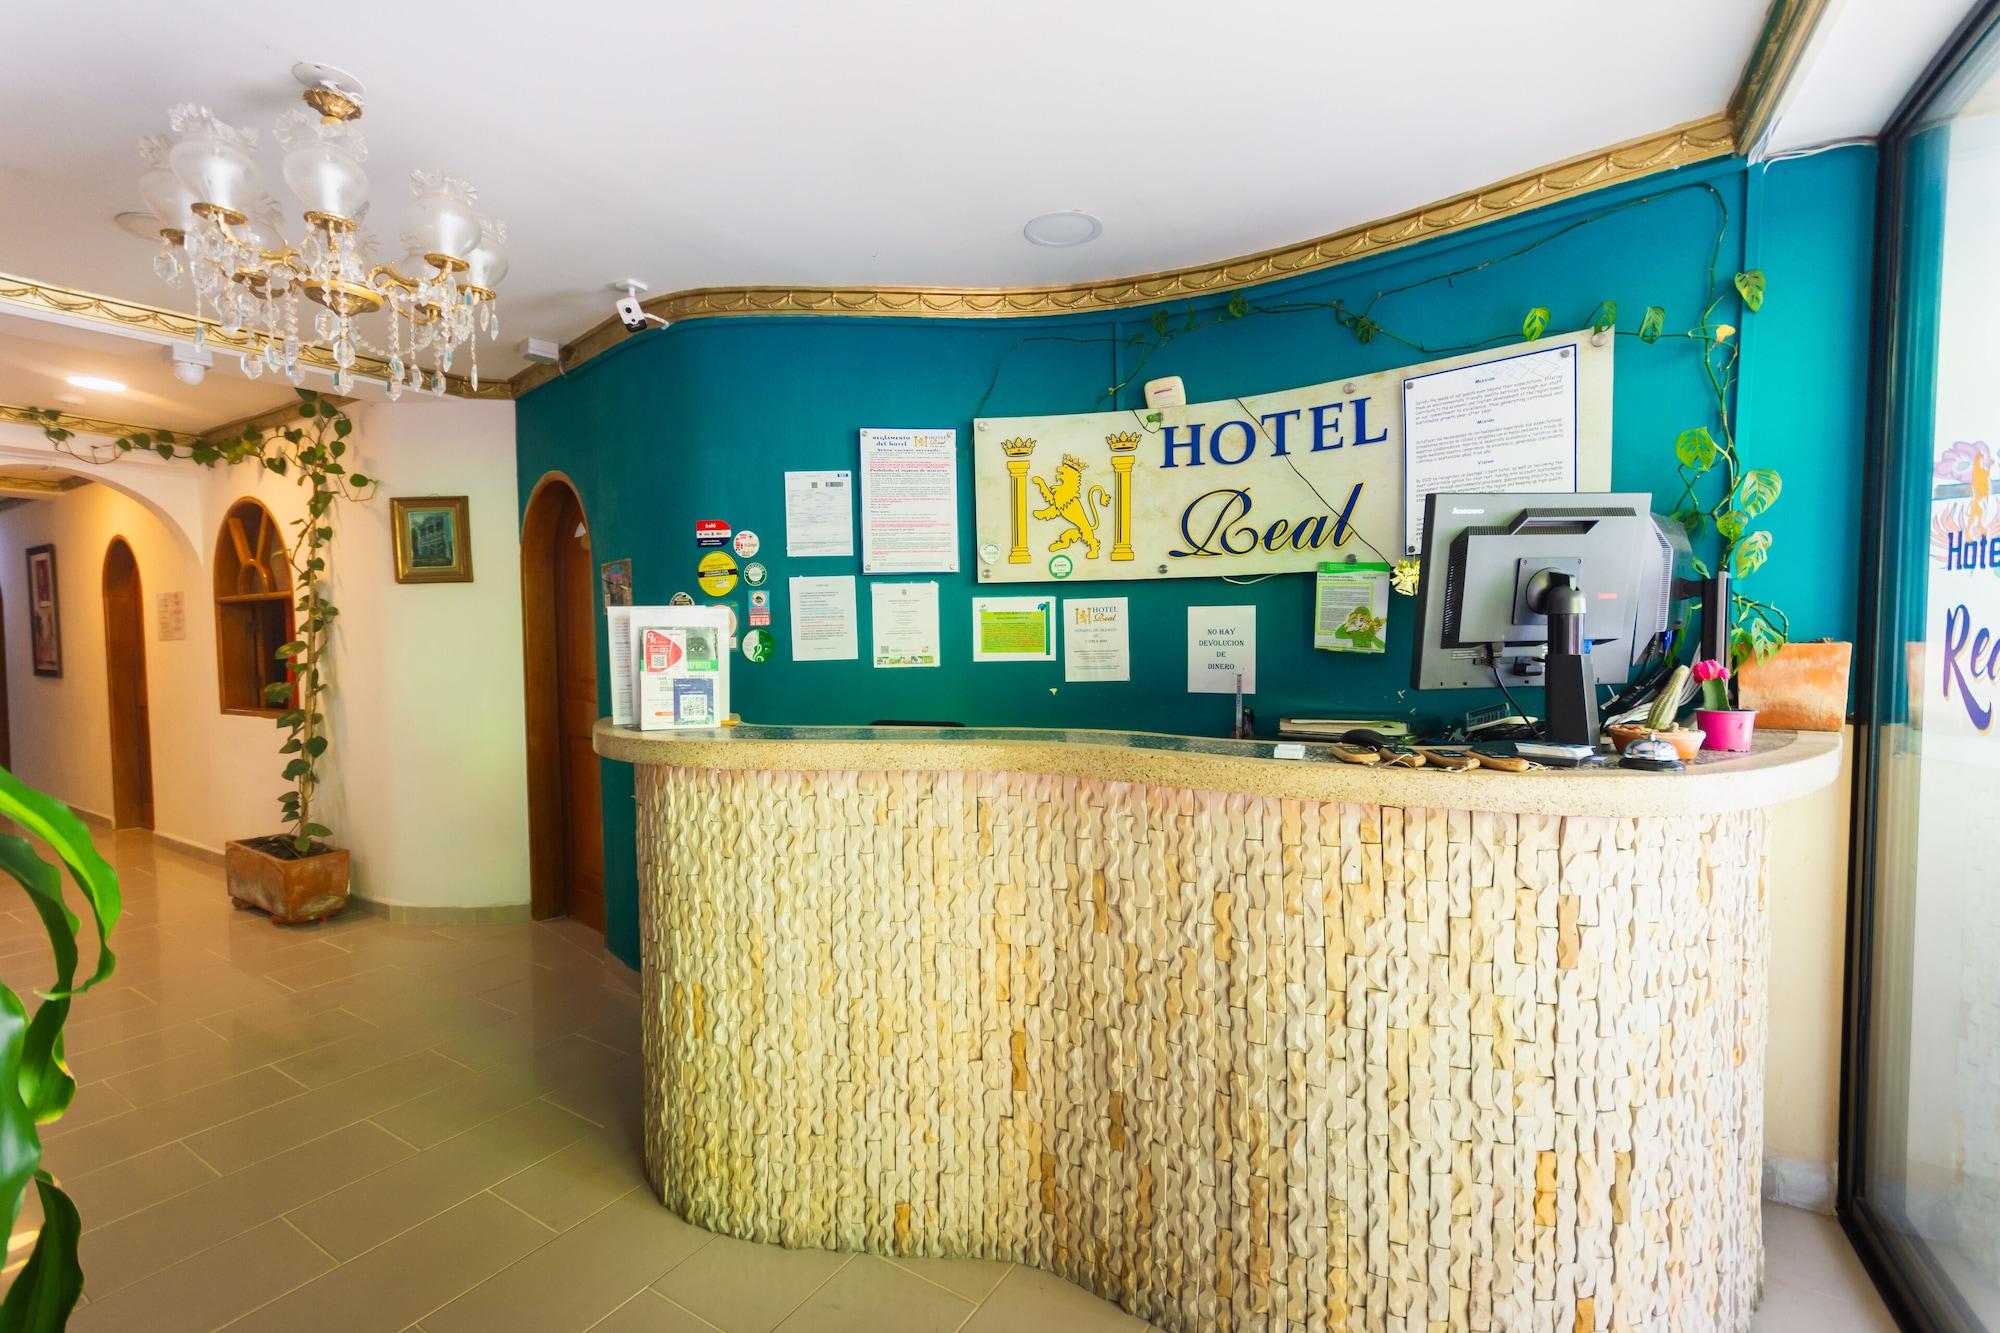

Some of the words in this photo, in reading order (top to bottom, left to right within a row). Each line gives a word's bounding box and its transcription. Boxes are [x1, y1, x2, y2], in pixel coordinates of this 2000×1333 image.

[1160, 396, 1388, 468] HOTEL
[1168, 482, 1364, 557] Real
[1092, 612, 1116, 622] Real
